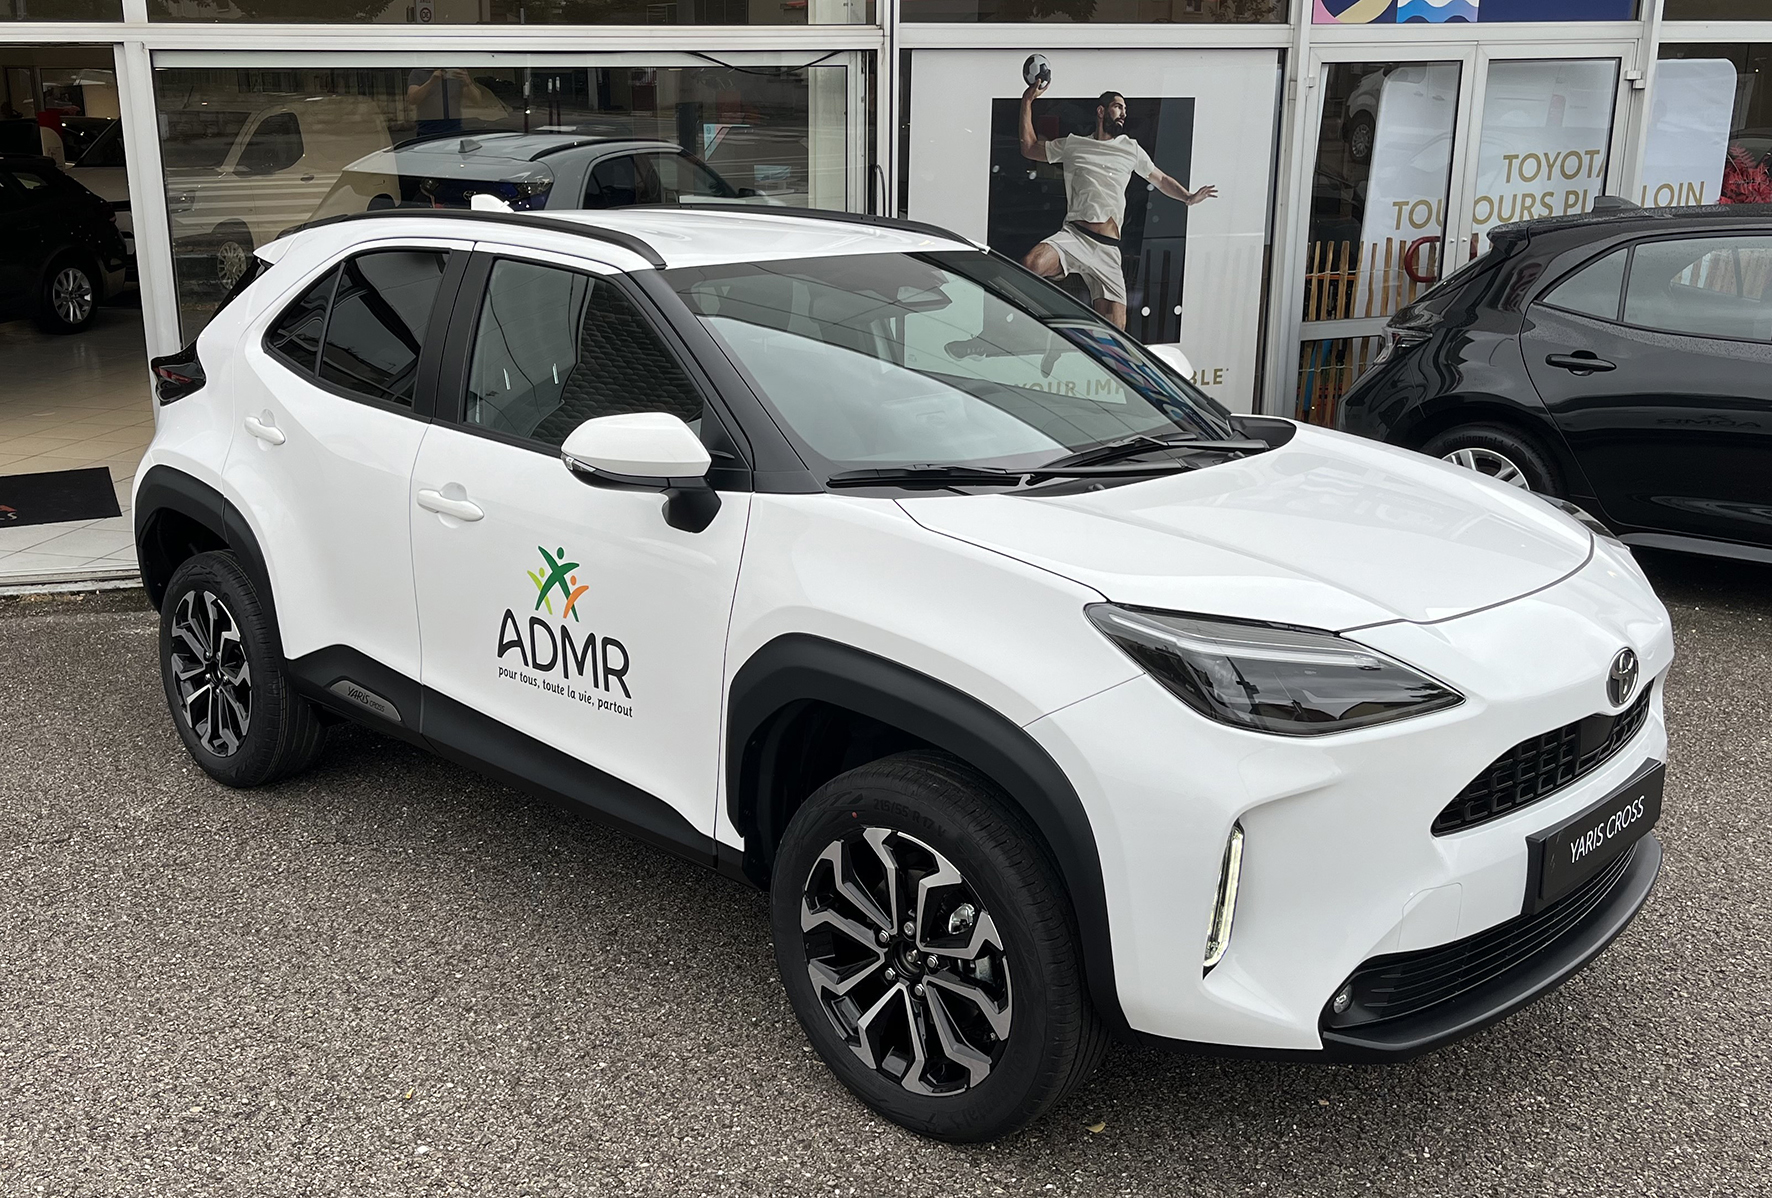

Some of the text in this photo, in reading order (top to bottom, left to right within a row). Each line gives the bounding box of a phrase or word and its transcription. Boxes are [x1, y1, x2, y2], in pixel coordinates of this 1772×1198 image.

[1502, 149, 1605, 184] TOYOT
[1392, 190, 1554, 230] TOOURS
[497, 608, 632, 699] ADMR
[498, 666, 633, 718] pour tous, toute la vie, partout
[873, 798, 910, 817] 215/55
[912, 810, 921, 823] R
[1569, 795, 1645, 863] YARIS CROSS
